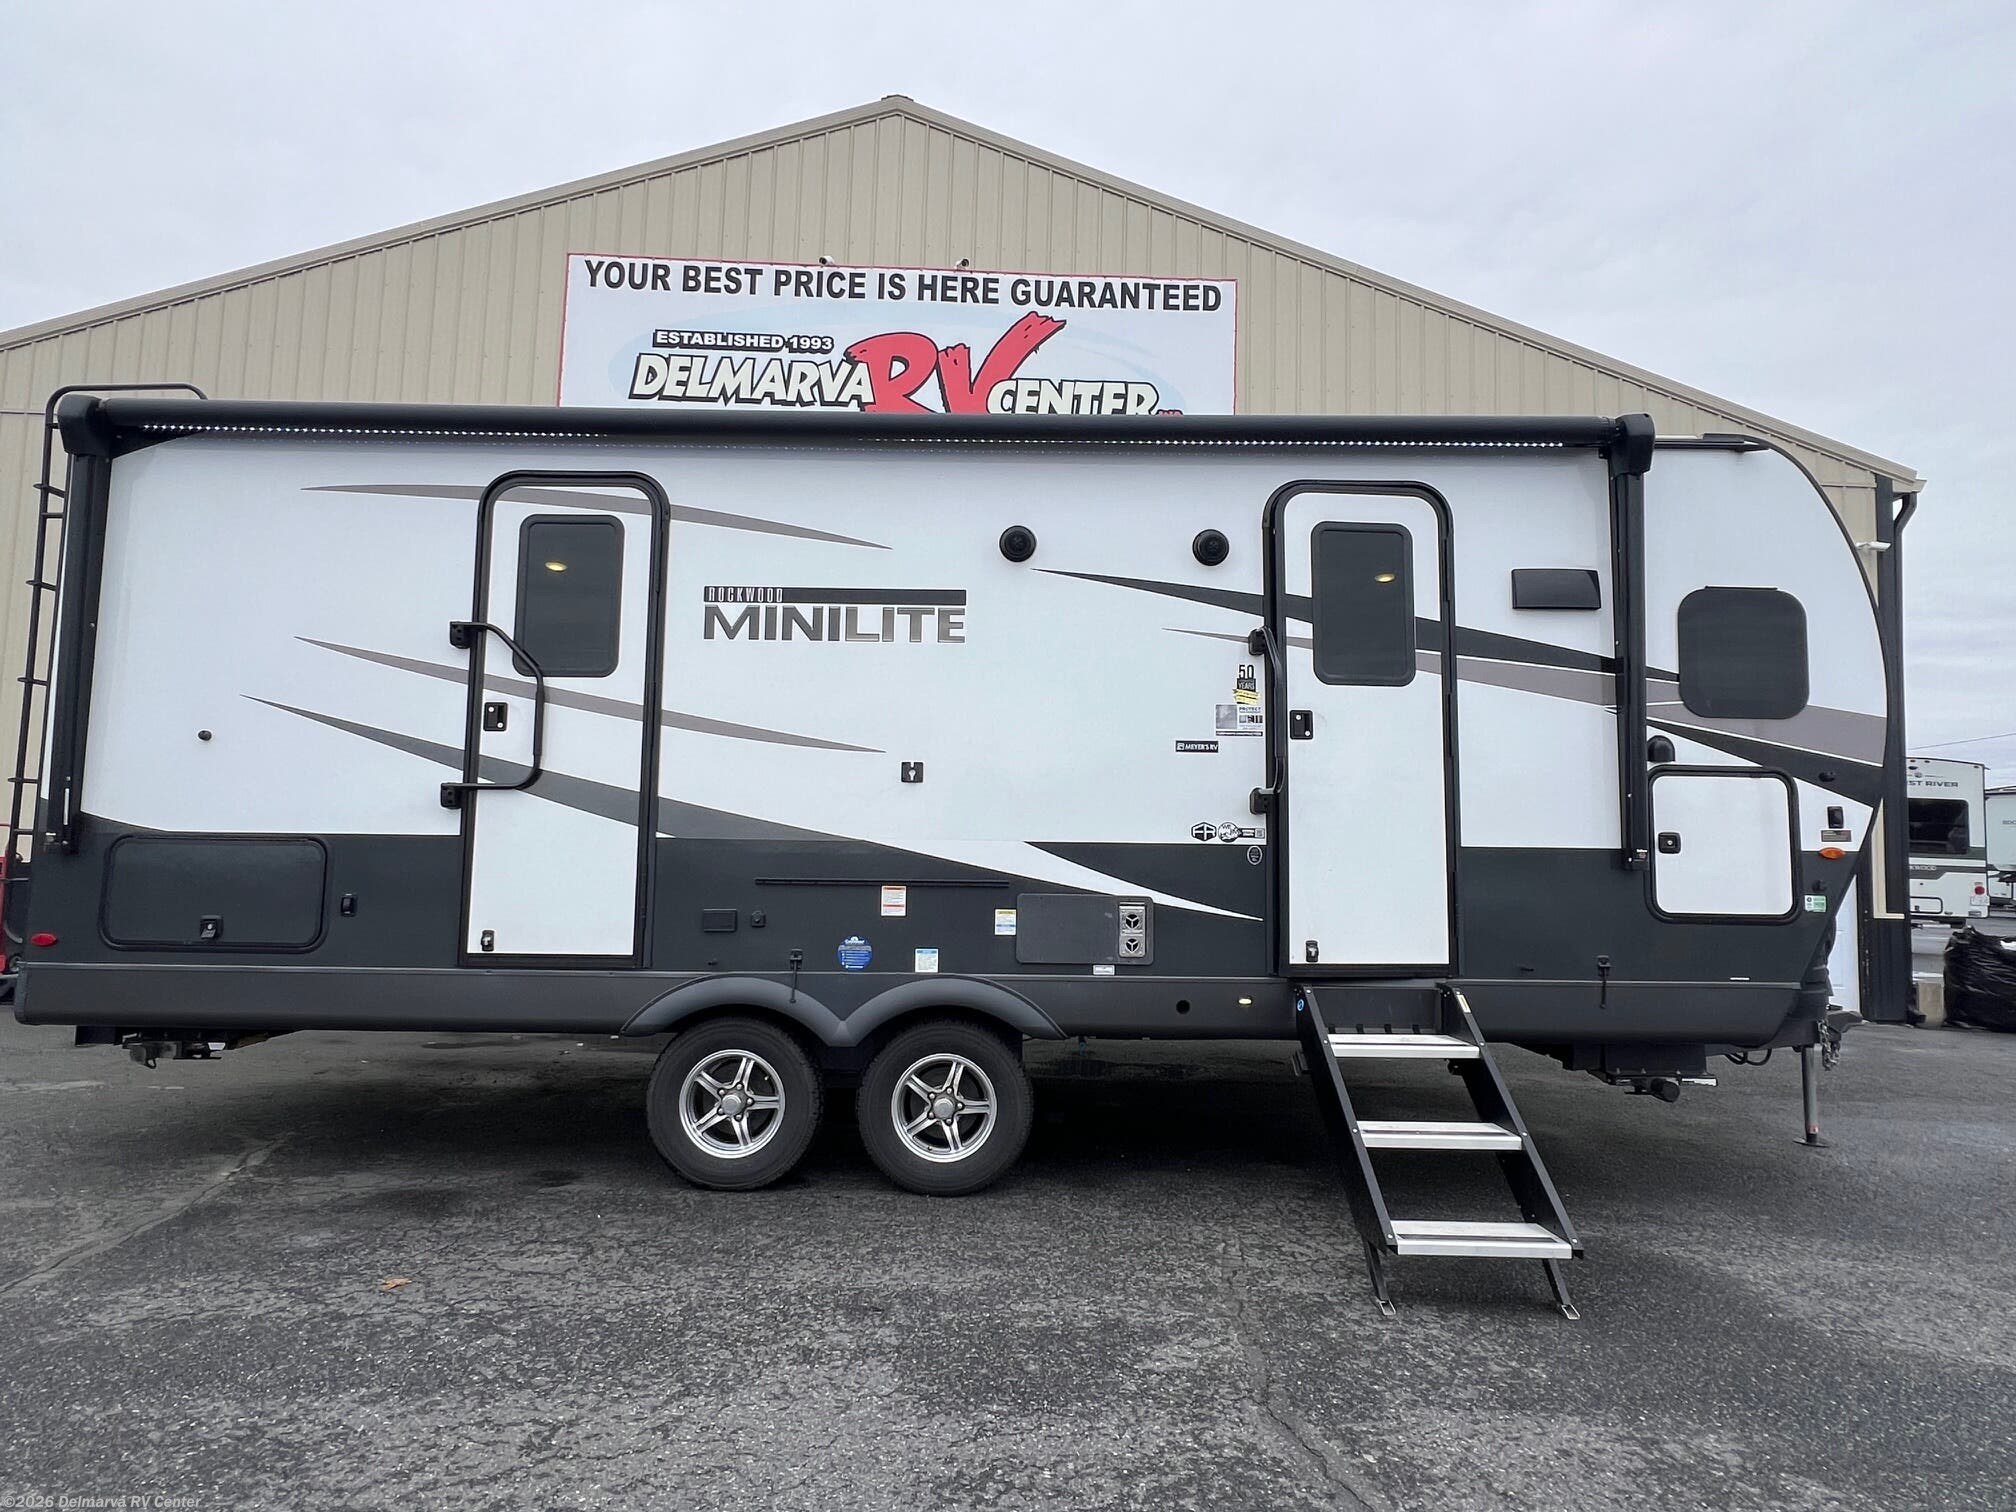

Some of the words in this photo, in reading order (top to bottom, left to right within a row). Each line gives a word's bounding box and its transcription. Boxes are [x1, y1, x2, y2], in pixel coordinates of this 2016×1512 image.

[584, 259, 672, 291] YOUR
[682, 265, 763, 296] BEST
[773, 269, 867, 300] PRICE
[877, 272, 907, 301] IS
[916, 274, 1000, 305] HERE
[1010, 278, 1222, 312] GUARANTEED
[655, 331, 785, 350] ESTABLISHED
[789, 336, 834, 351] 1993
[629, 352, 876, 407] DELMARVA
[845, 311, 1067, 414] RV
[987, 377, 1159, 415] CENTER
[708, 586, 783, 603] ROCKWOOD
[703, 604, 966, 643] MINILITE
[1238, 664, 1255, 680] 50
